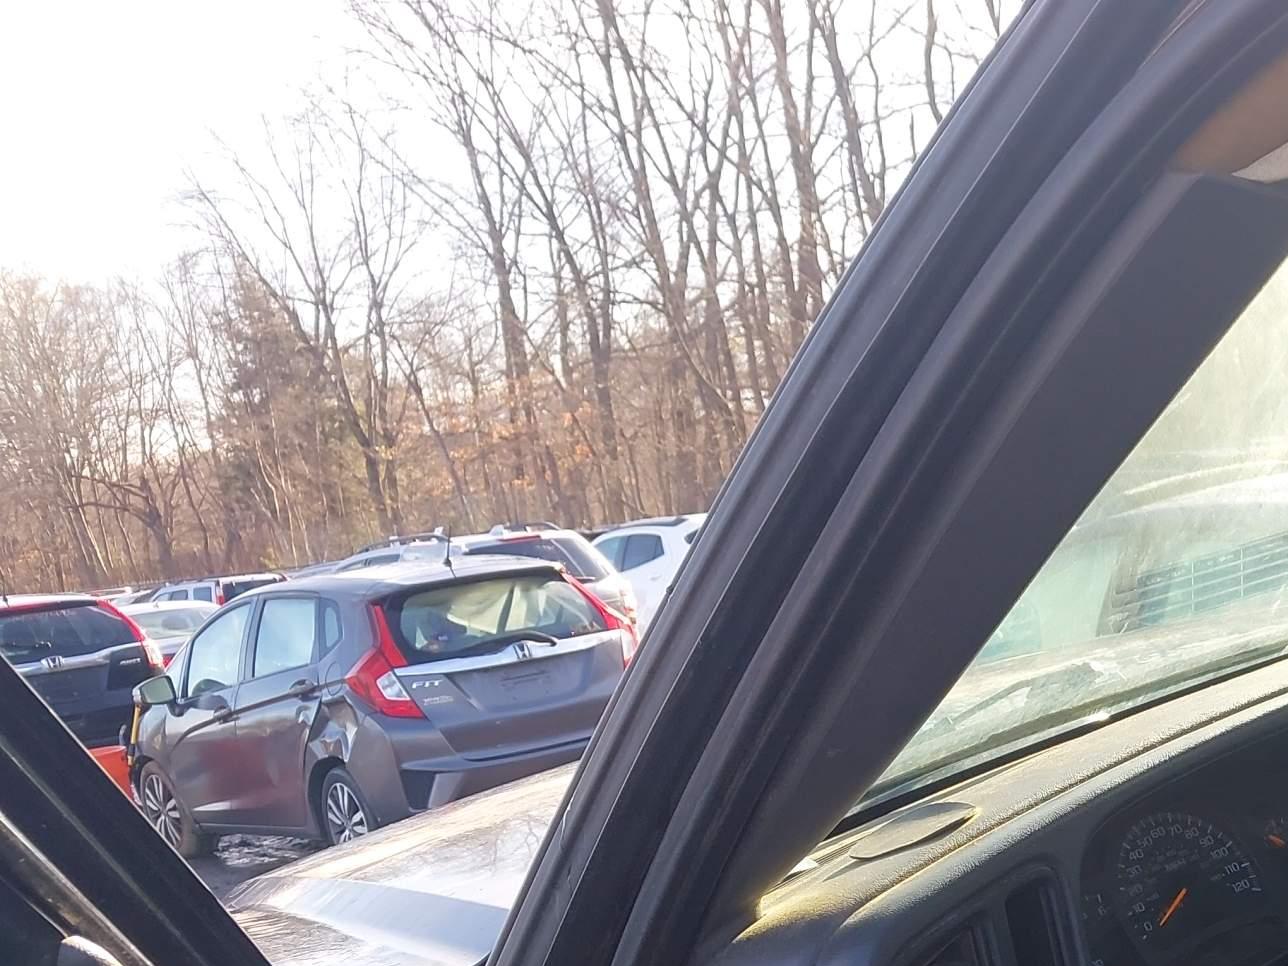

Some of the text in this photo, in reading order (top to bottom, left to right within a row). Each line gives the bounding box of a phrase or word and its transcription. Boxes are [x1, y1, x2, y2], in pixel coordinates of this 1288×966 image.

[1150, 826, 1166, 839] 60
[1168, 823, 1183, 836] 70
[1136, 836, 1153, 849] 50
[1199, 834, 1215, 848] 90
[1128, 848, 1144, 861] 40
[1210, 847, 1229, 859] 100
[1126, 864, 1142, 878] 30
[1225, 862, 1240, 875] 110
[1231, 879, 1250, 893] 120
